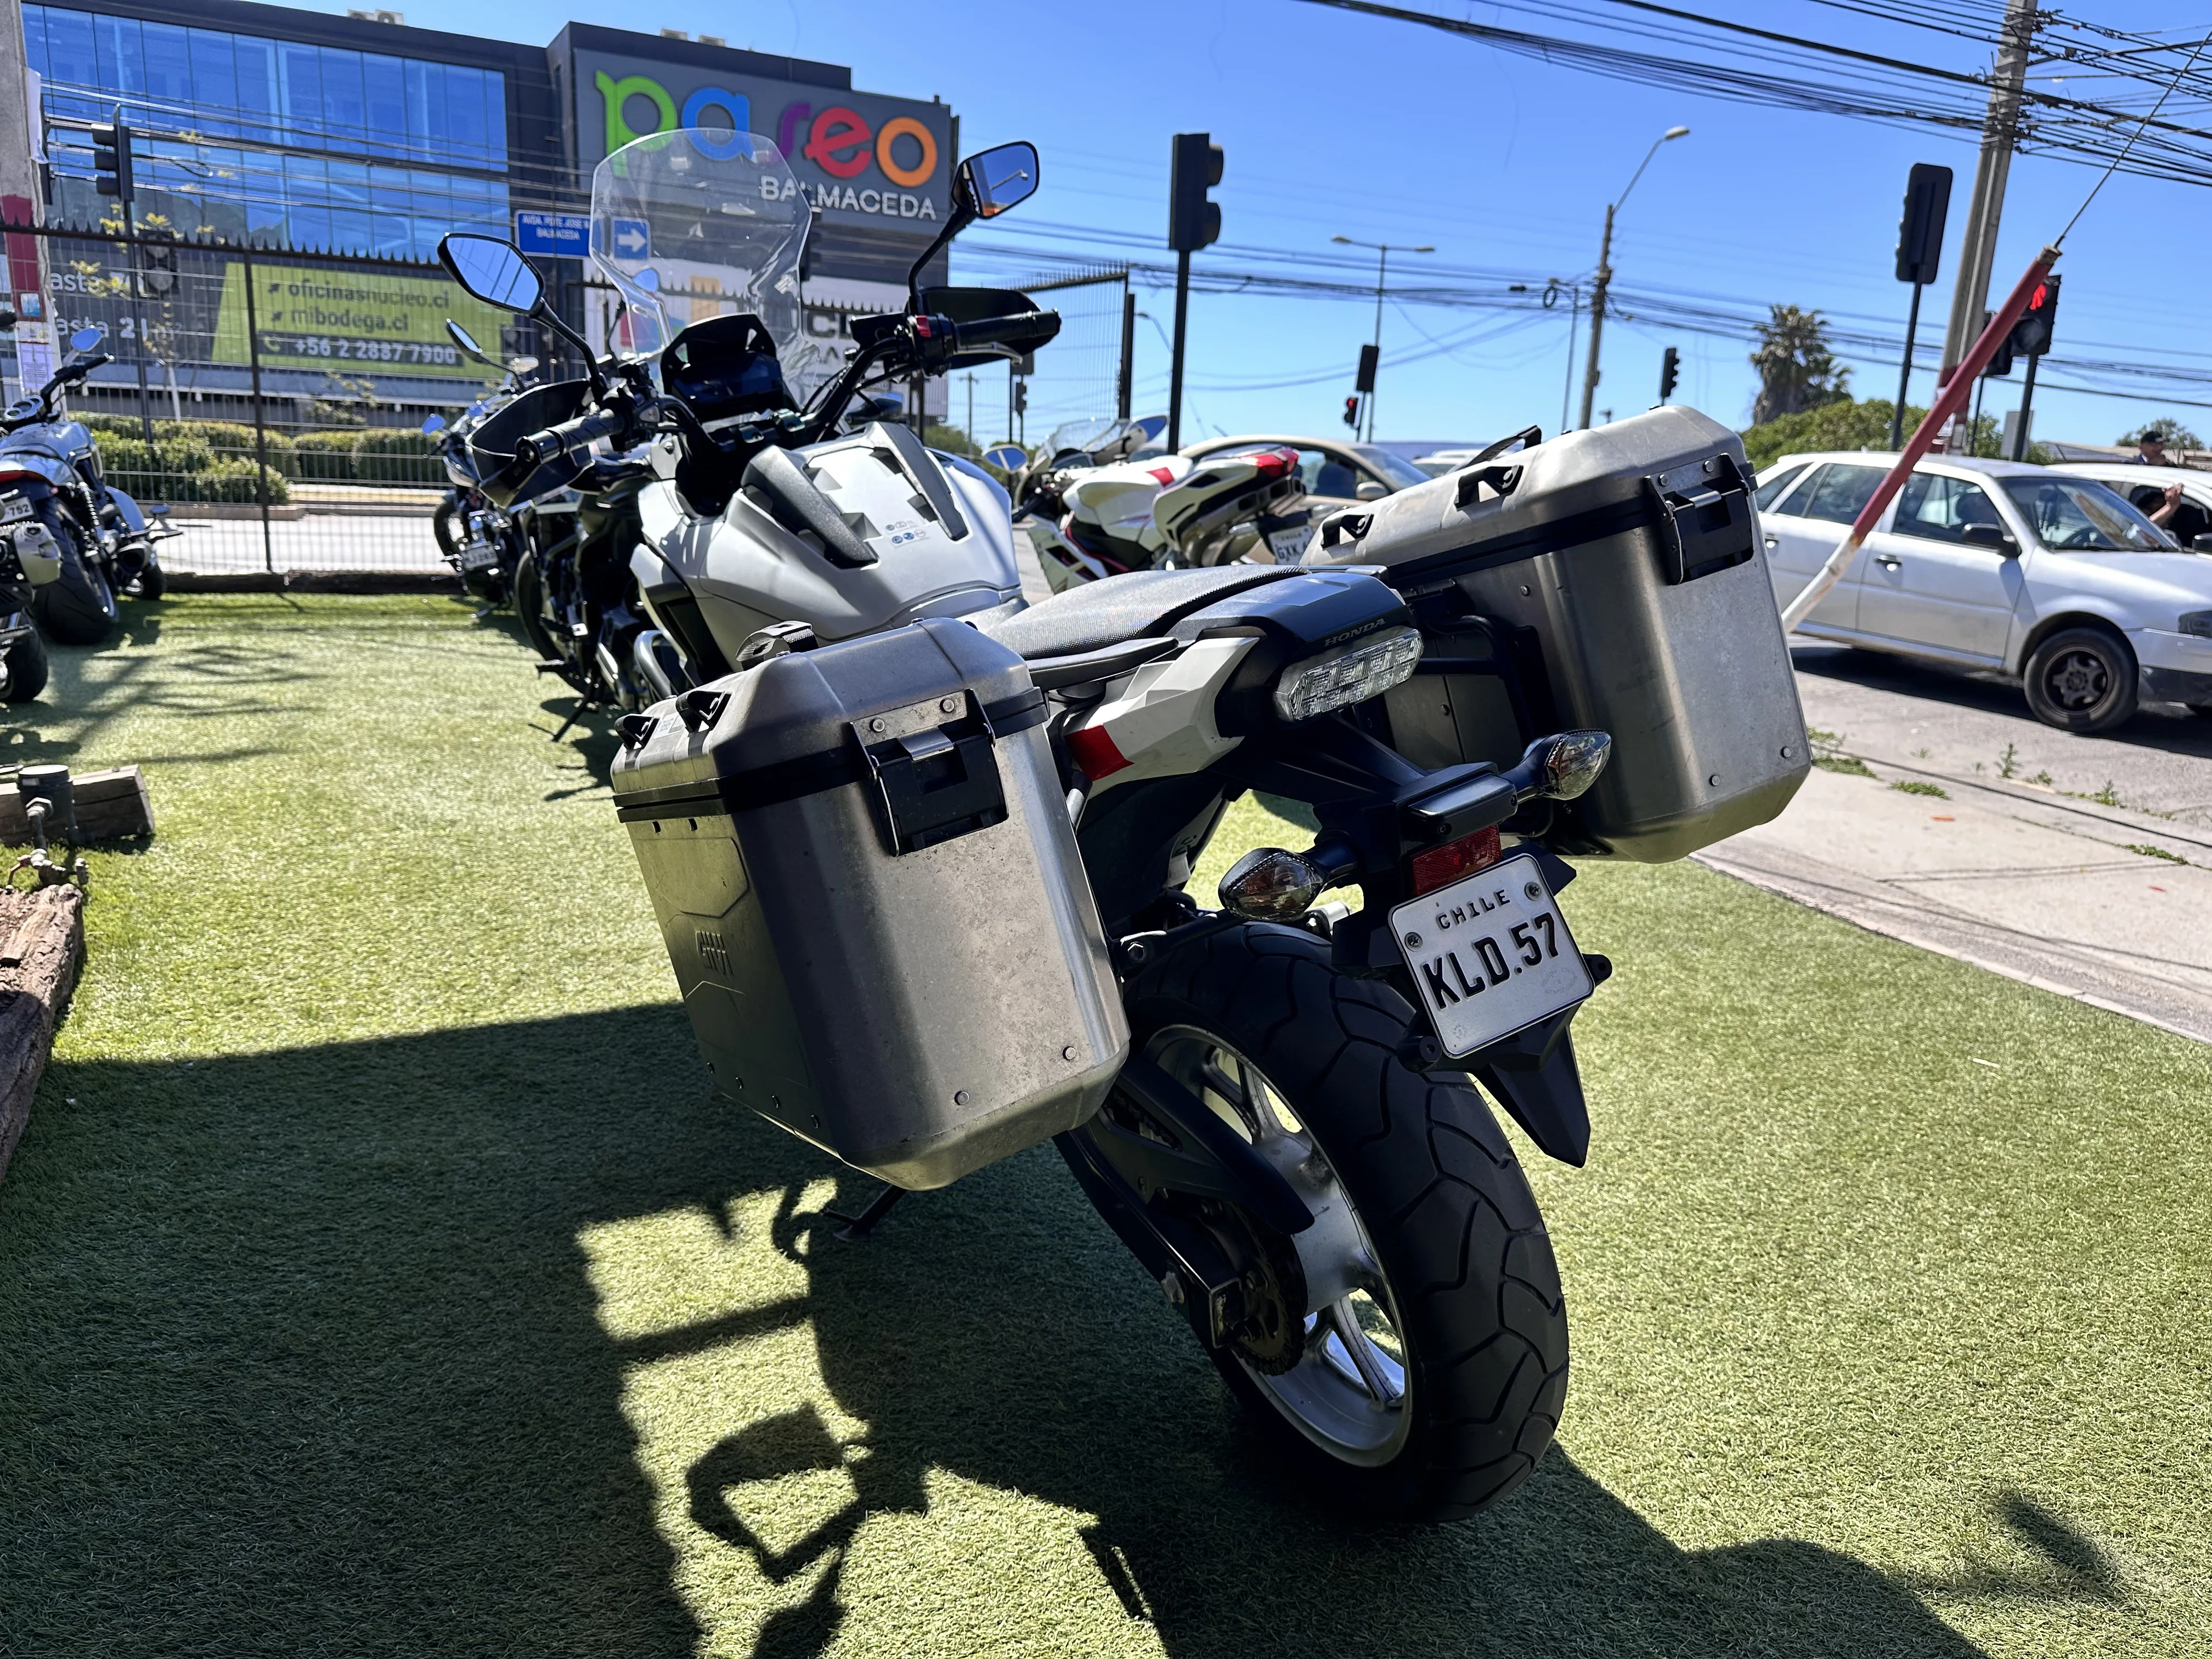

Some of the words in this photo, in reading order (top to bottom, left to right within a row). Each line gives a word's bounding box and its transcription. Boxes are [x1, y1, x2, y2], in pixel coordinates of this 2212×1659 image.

[595, 70, 937, 187] paseo
[338, 337, 350, 358] 2
[1324, 618, 1386, 647] HONDA
[1437, 889, 1510, 930] CHILE
[1422, 912, 1559, 1009] KLD.57
